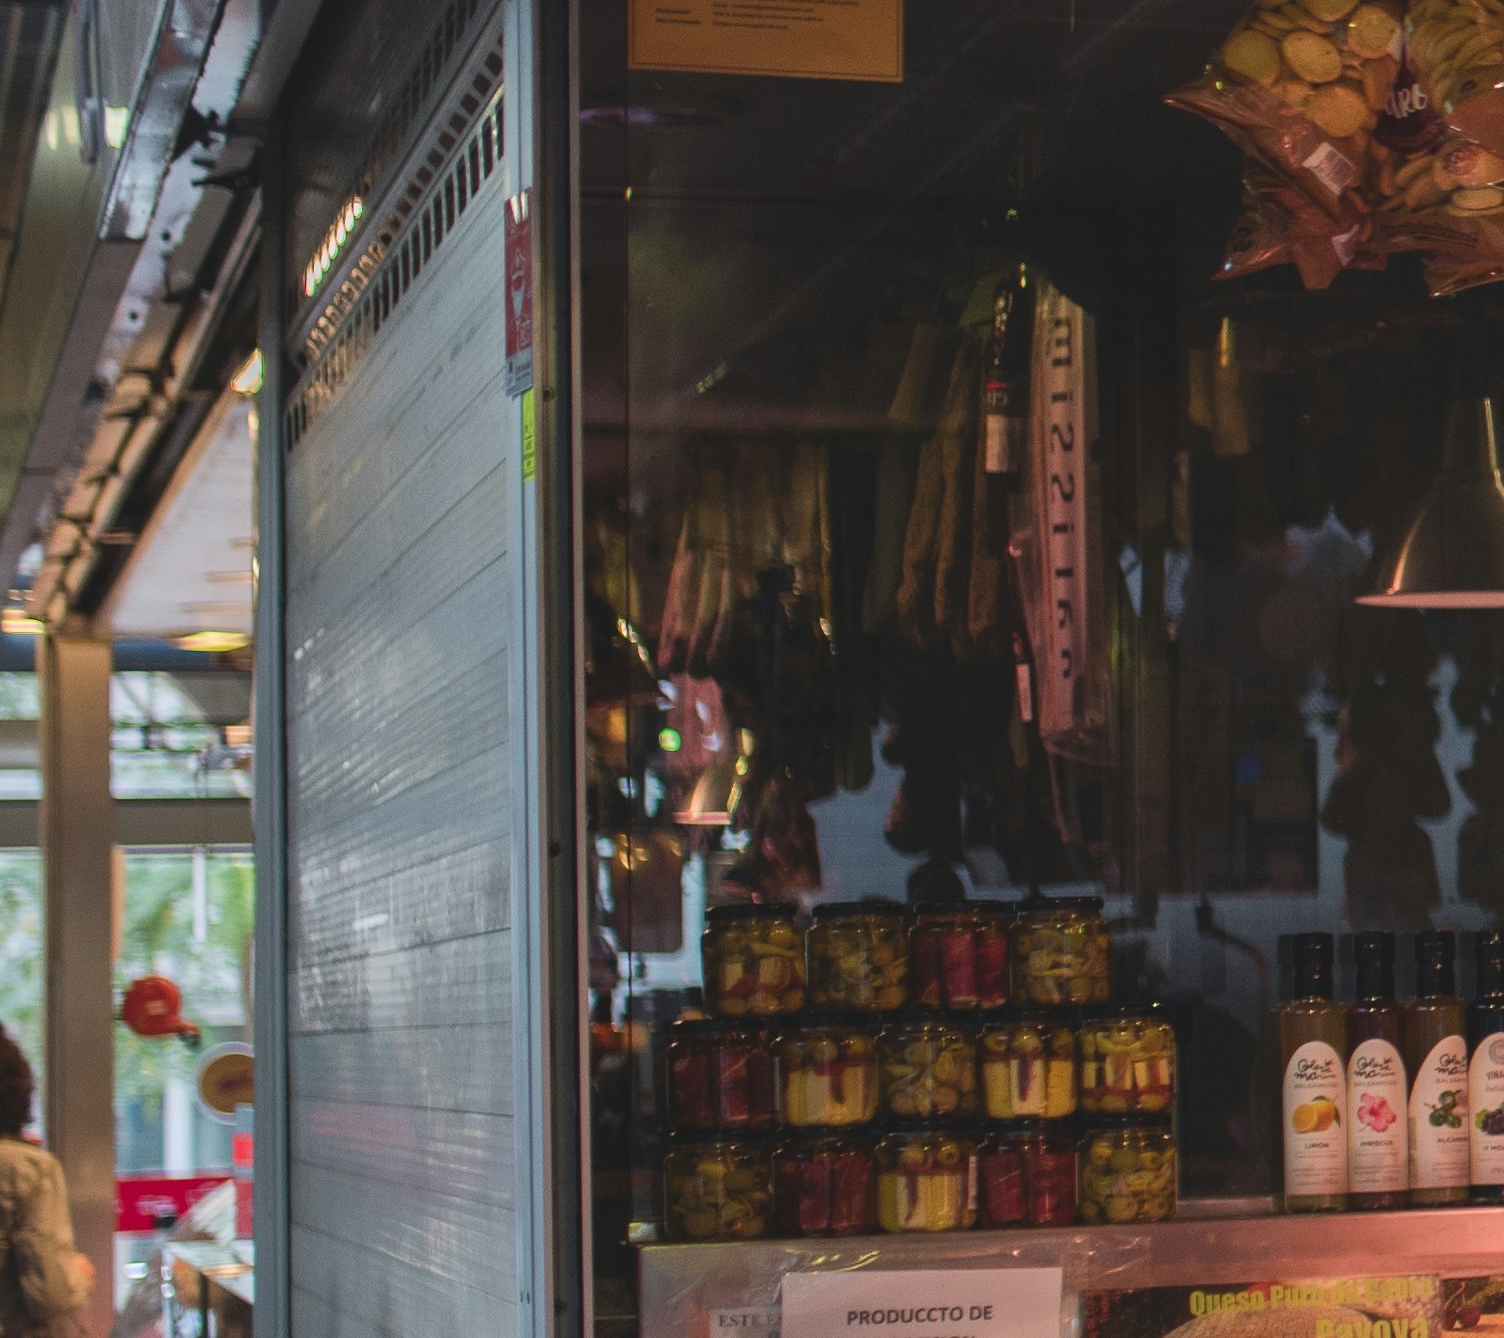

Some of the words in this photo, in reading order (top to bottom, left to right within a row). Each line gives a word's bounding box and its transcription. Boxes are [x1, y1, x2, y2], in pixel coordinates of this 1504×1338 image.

[1189, 1290, 1265, 1316] Queso
[1271, 1286, 1319, 1310] Puro
[847, 1306, 963, 1326] PRODUCCTO
[969, 1305, 993, 1320] DE
